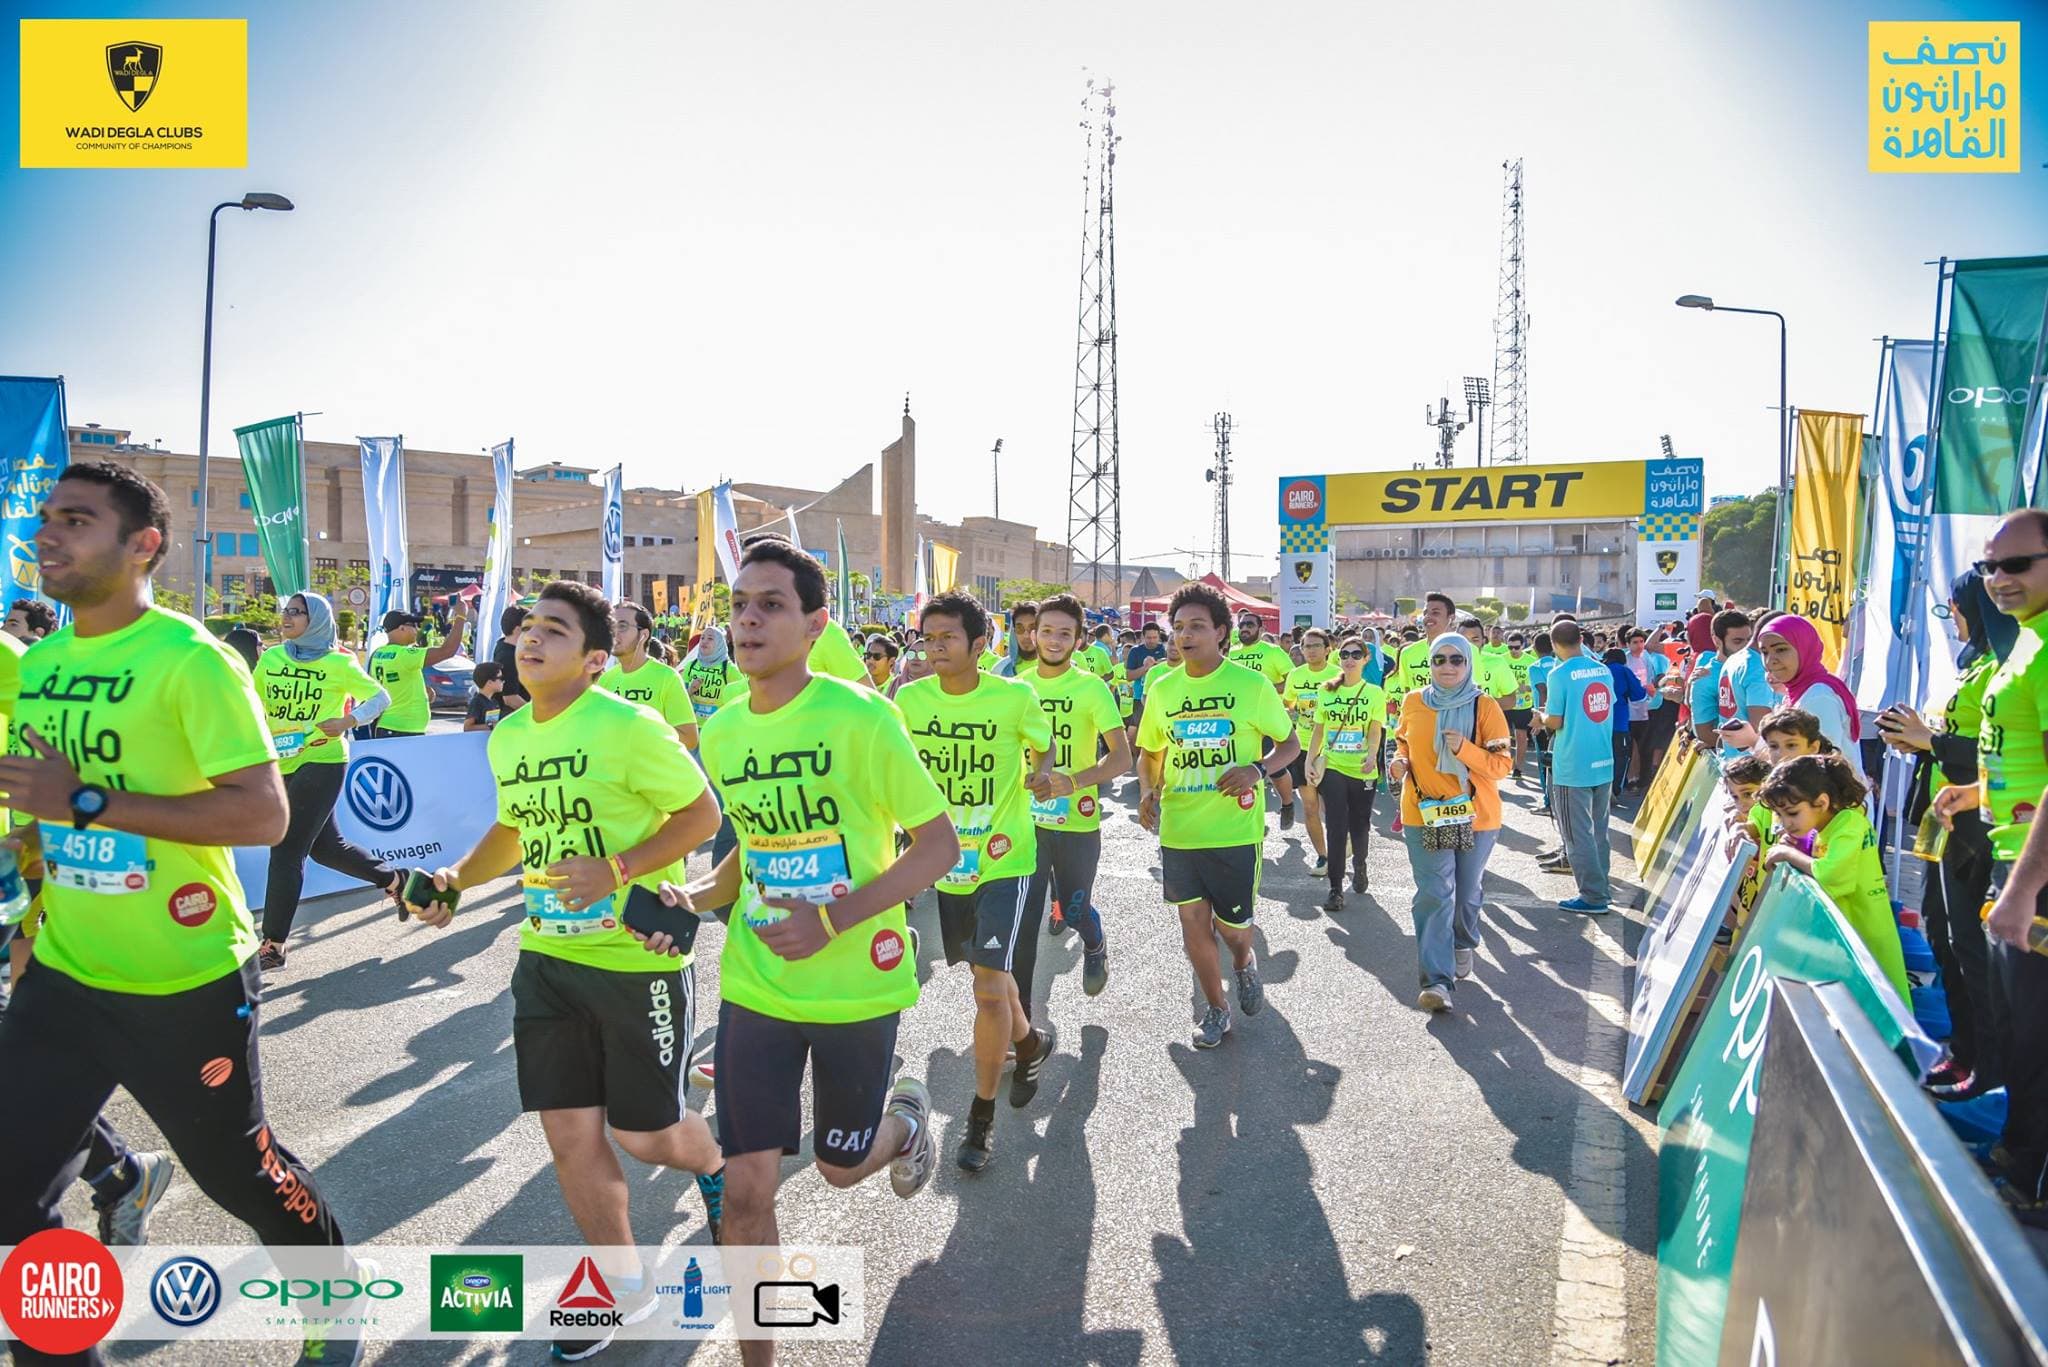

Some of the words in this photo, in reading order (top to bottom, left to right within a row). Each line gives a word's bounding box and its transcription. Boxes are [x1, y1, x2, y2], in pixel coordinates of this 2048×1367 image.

[1651, 463, 1699, 476] نصف
[1289, 491, 1315, 502] CAIRO
[1381, 472, 1584, 514] START
[1651, 476, 1699, 496] ماراثون
[1651, 493, 1698, 508] القاهرة
[19, 664, 135, 703] نصف
[266, 664, 326, 681] نصف
[1166, 693, 1235, 717] نصف
[912, 715, 997, 741] نصف
[1187, 722, 1217, 735] 6424
[498, 748, 588, 787] نصف
[721, 742, 832, 787] نصف
[918, 744, 995, 780] ماراثو
[1188, 784, 1203, 792] Half
[1435, 804, 1467, 816] 1469
[955, 825, 992, 836] arathon
[63, 834, 115, 863] 4518
[371, 841, 442, 863] lkswagen
[768, 853, 819, 880] 4924
[175, 891, 209, 910] CAIRO
[875, 936, 899, 955] CAIRO
[649, 979, 675, 1067] adidas
[1722, 945, 1775, 1115] opp
[826, 1127, 873, 1152] GAP
[258, 1149, 318, 1225] adidas
